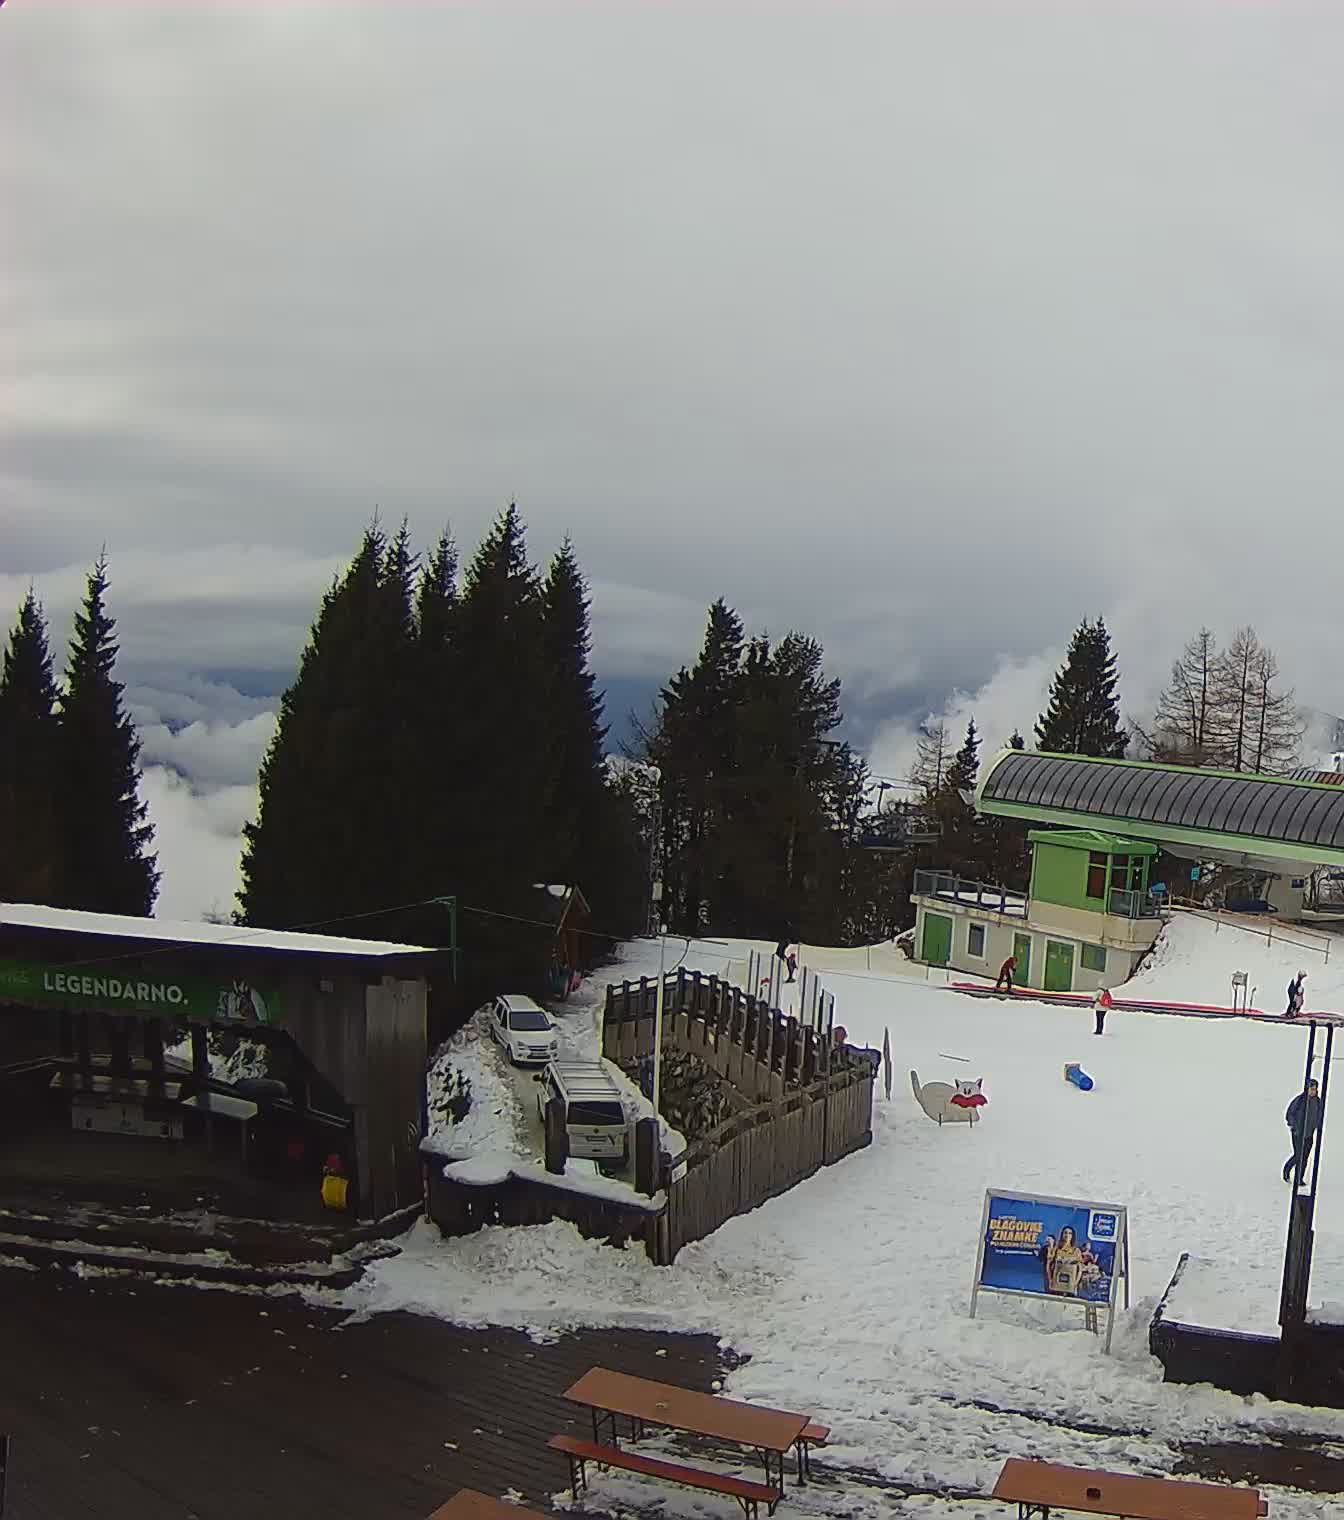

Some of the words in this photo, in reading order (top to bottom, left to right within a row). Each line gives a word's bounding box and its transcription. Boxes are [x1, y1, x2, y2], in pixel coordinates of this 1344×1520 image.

[43, 972, 189, 1005] LEGENDARNO.
[990, 1219, 1043, 1233] BLAGOVNE
[992, 1230, 1039, 1243] ZNAMKE
